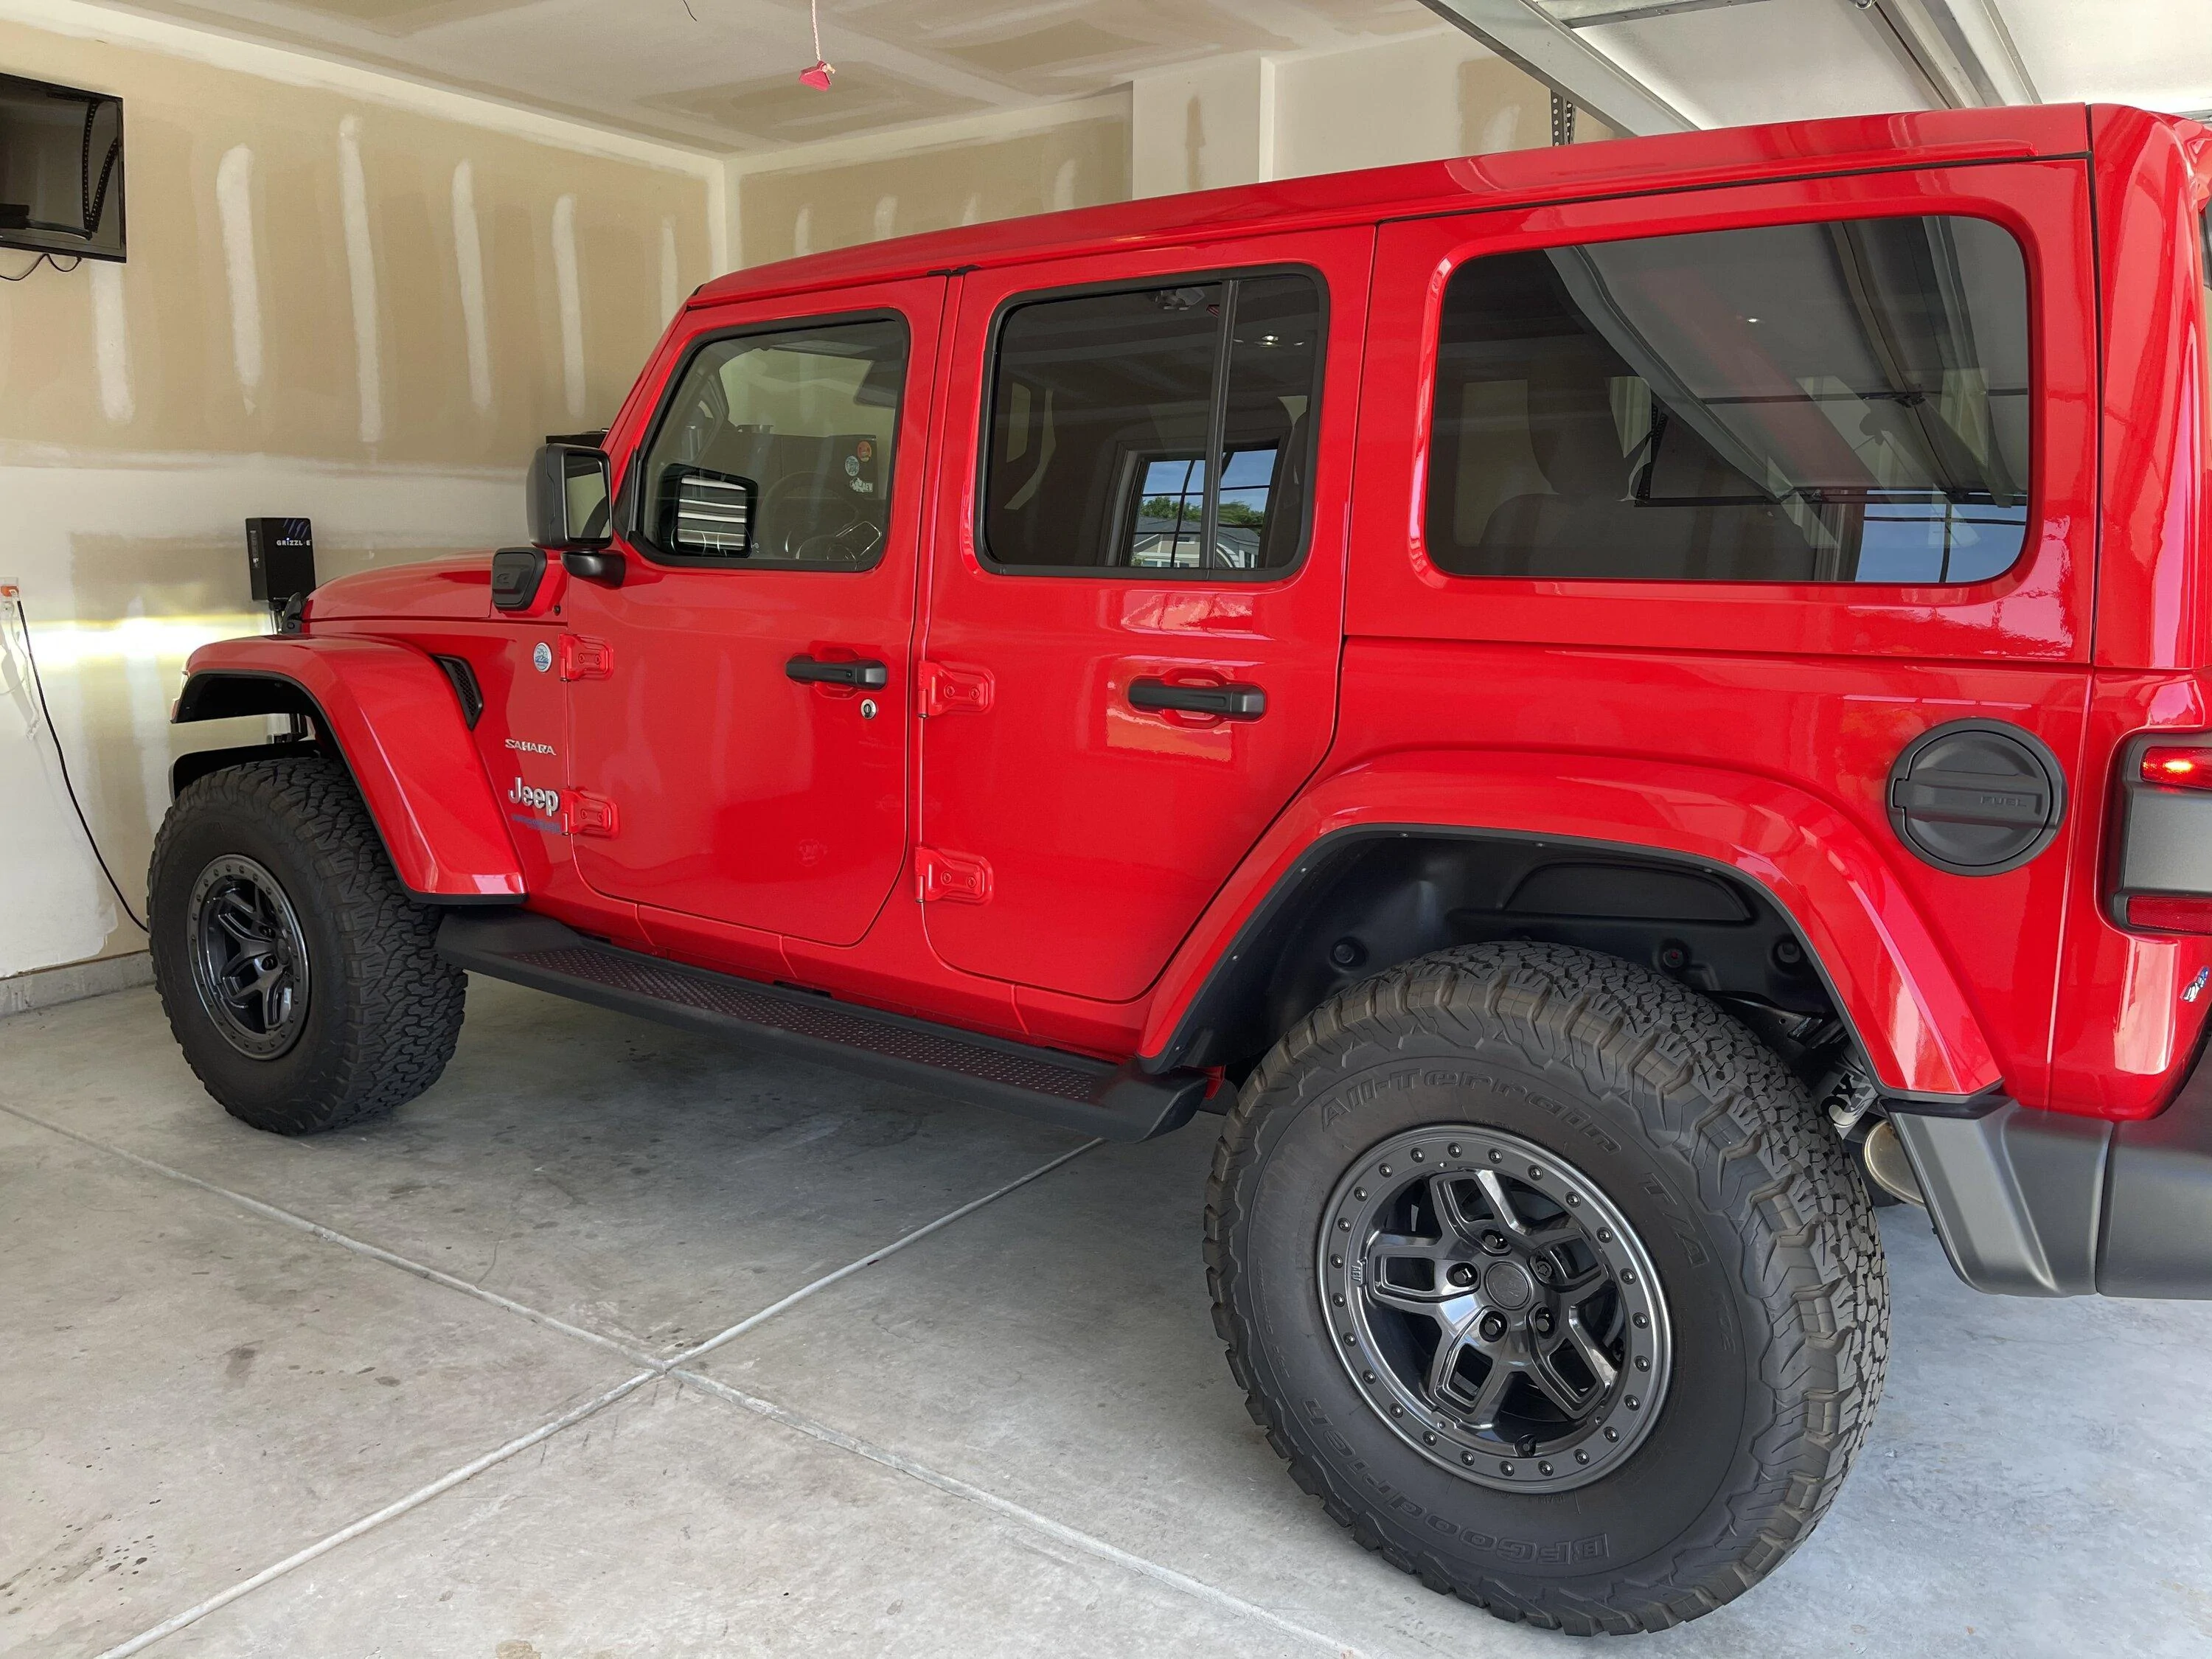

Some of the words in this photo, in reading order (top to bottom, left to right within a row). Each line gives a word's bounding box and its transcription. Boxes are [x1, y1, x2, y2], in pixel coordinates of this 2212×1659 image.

[505, 738, 557, 756] SAHARA
[507, 776, 559, 816] Jeep
[1979, 796, 2027, 807] FUEL
[1321, 1067, 1622, 1155] All-Terrain
[1300, 1397, 1610, 1565] BFGoodrich
